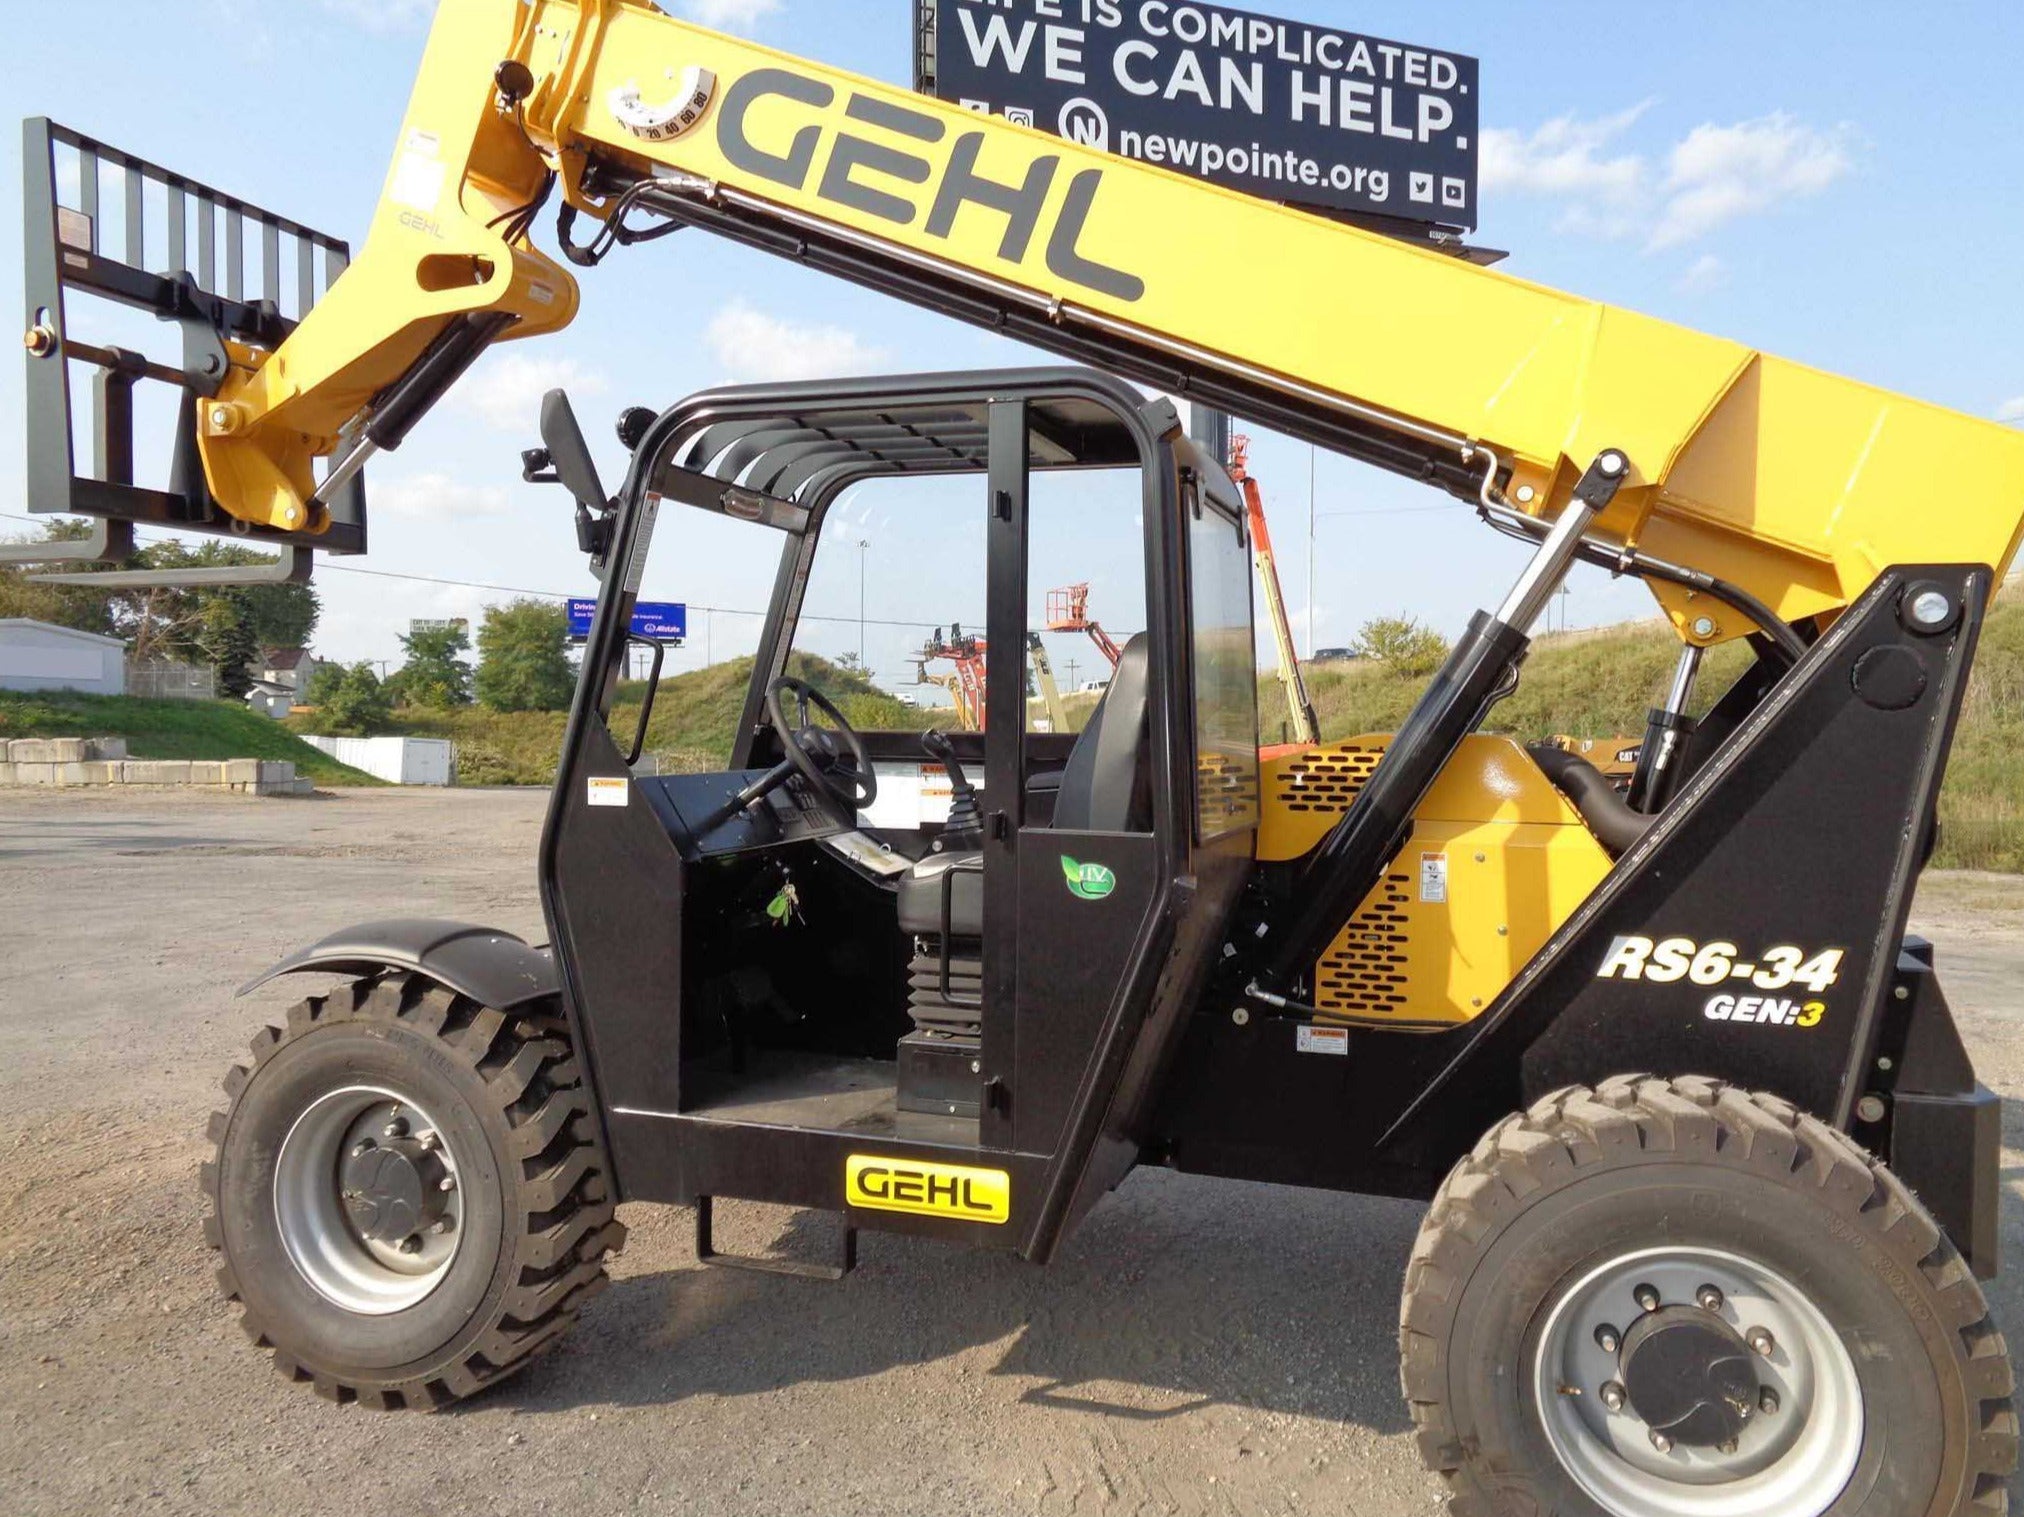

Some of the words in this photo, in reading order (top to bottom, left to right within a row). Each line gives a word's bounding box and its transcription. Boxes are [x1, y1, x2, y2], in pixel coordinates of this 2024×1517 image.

[1138, 0, 1468, 94] COMPLICATED.
[957, 8, 1086, 85] WE
[1113, 40, 1264, 115] CAN
[1291, 69, 1468, 150] HELP.
[647, 128, 661, 139] 20
[664, 121, 680, 135] 40
[680, 109, 696, 125] 60
[693, 91, 708, 108] 80
[716, 67, 1145, 302] GEHL
[1119, 129, 1389, 203] newpointe.org
[399, 210, 445, 240] GEHL
[573, 603, 596, 611] Drivin
[1619, 751, 1634, 762] CAT
[1596, 935, 1845, 992] RS6-34
[857, 1166, 993, 1211] GEHL
